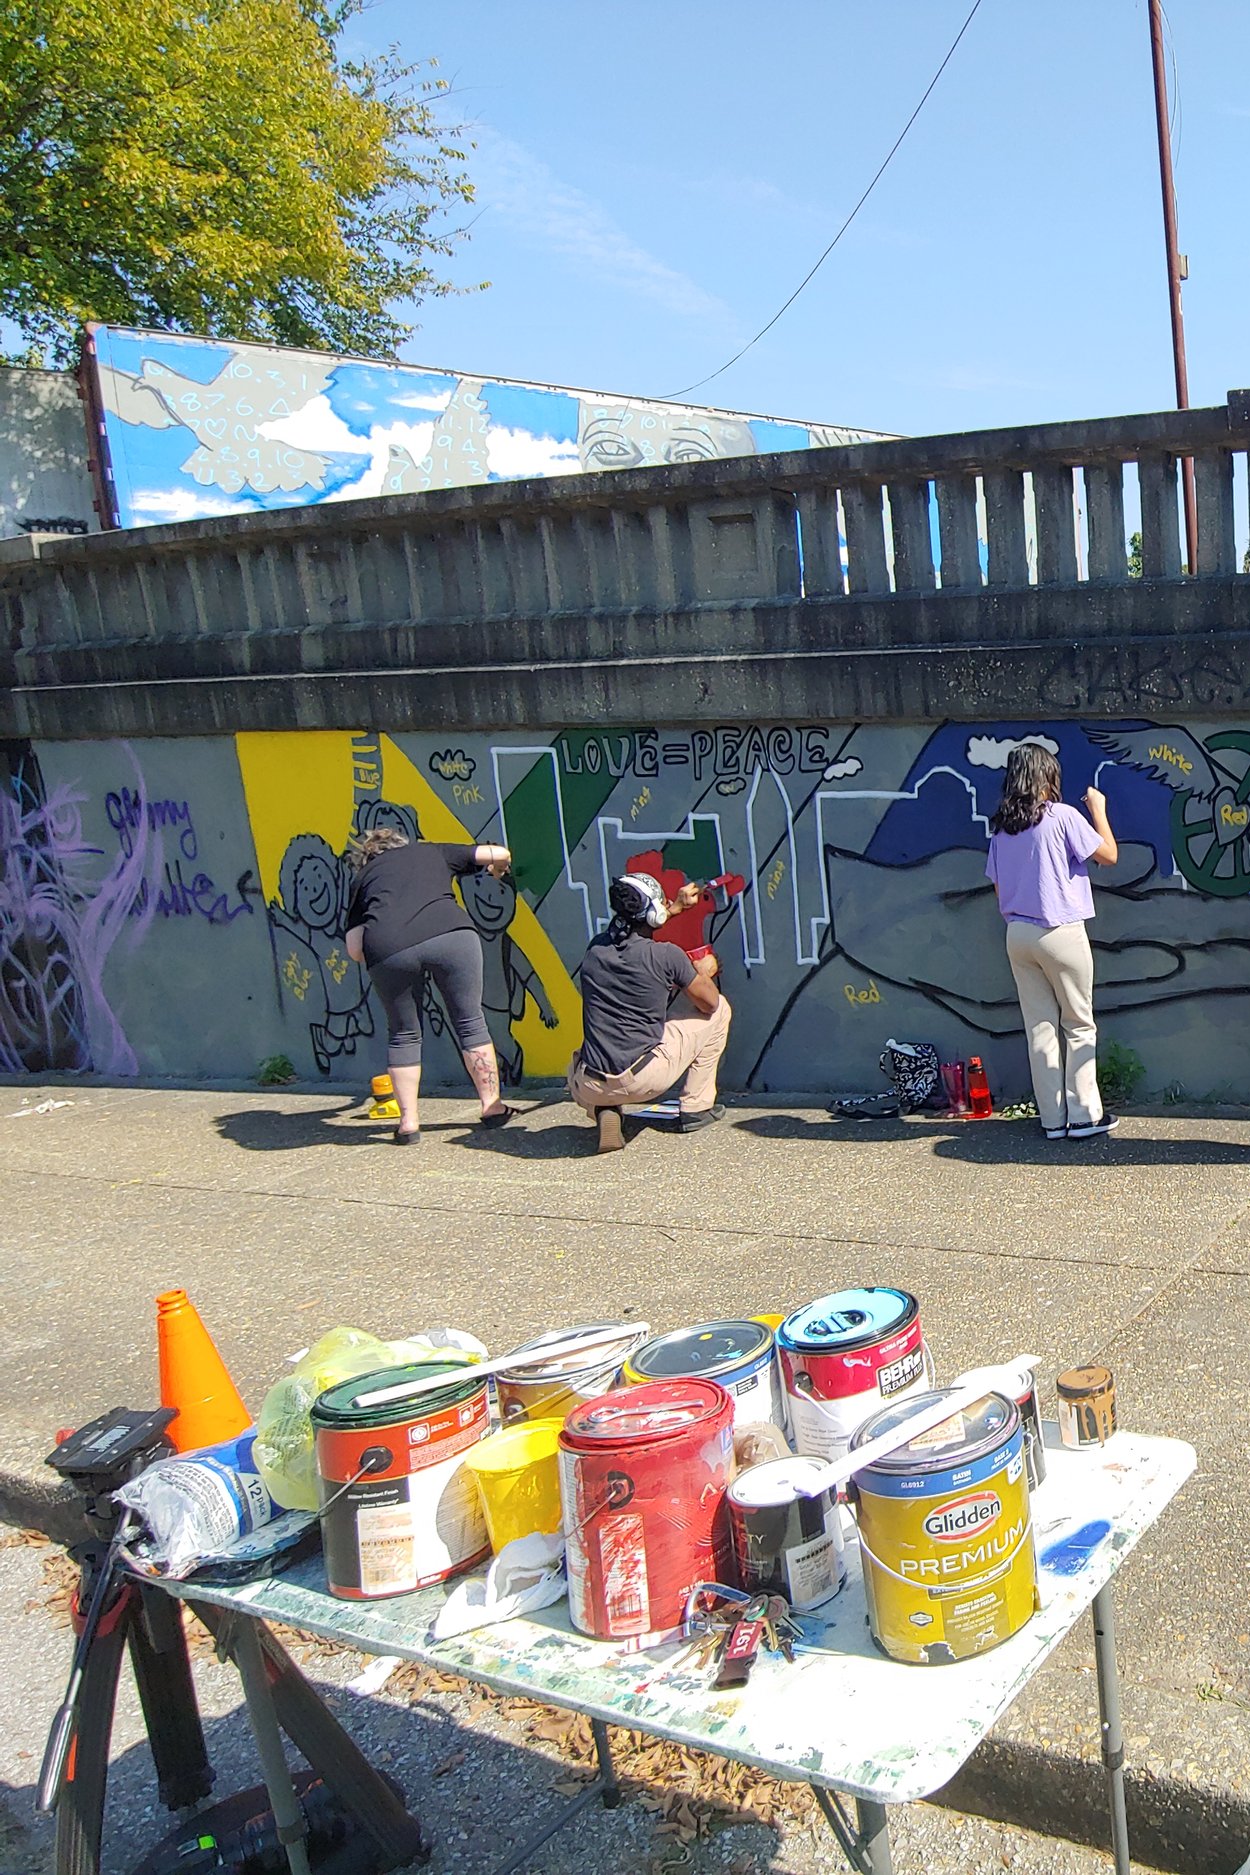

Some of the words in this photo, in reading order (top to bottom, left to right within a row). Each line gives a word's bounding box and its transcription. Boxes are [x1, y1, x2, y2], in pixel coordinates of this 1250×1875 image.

[1148, 744, 1194, 776] White
[453, 784, 486, 807] Pink
[1221, 804, 1248, 827] Red
[844, 979, 881, 1008] Red
[880, 1351, 921, 1387] BEHR
[248, 1479, 262, 1500] 12
[926, 1500, 1001, 1535] Glidden
[900, 1517, 1024, 1577] PREMIUM
